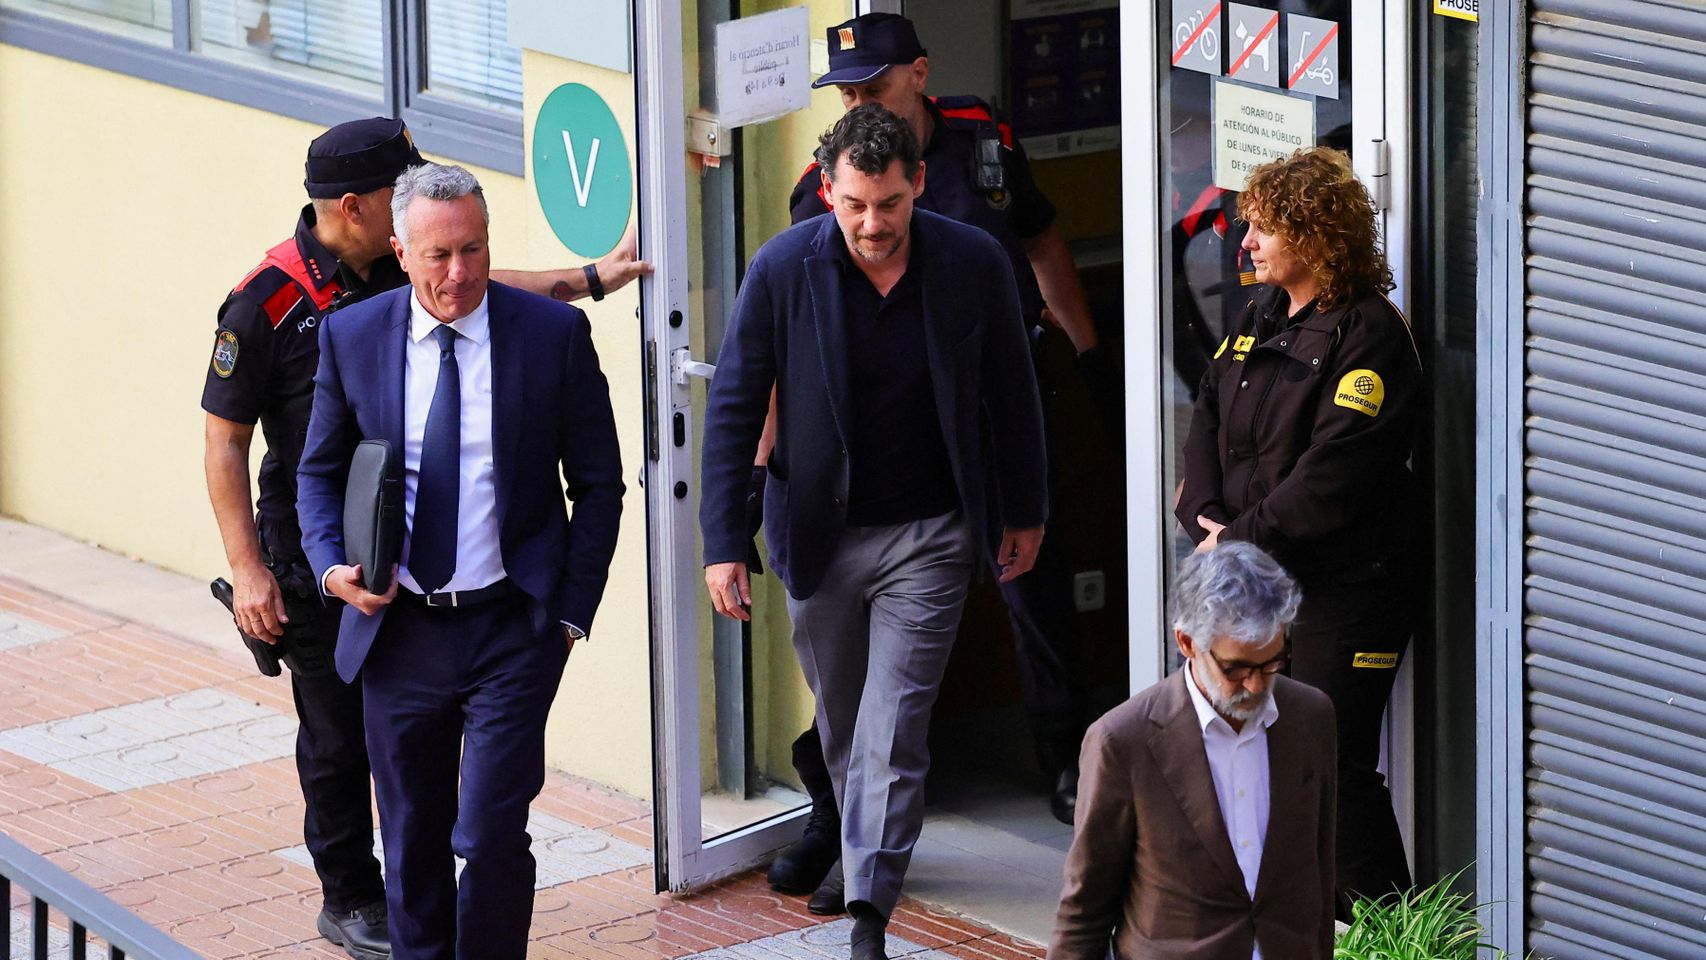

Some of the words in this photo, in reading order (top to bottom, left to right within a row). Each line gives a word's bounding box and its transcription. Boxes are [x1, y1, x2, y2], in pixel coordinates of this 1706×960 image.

[1241, 105, 1273, 121] HORARIO
[1275, 113, 1285, 124] DE
[1223, 119, 1260, 136] ATENCIÓN
[1261, 128, 1270, 138] AL
[1271, 129, 1302, 146] PÚBLICO
[1226, 139, 1237, 150] DE
[1239, 142, 1261, 156] LUNES
[1262, 148, 1268, 158] A
[562, 129, 601, 208] V
[1231, 159, 1241, 170] DE
[297, 316, 316, 333] PO
[1338, 393, 1378, 411] PROSEGUR
